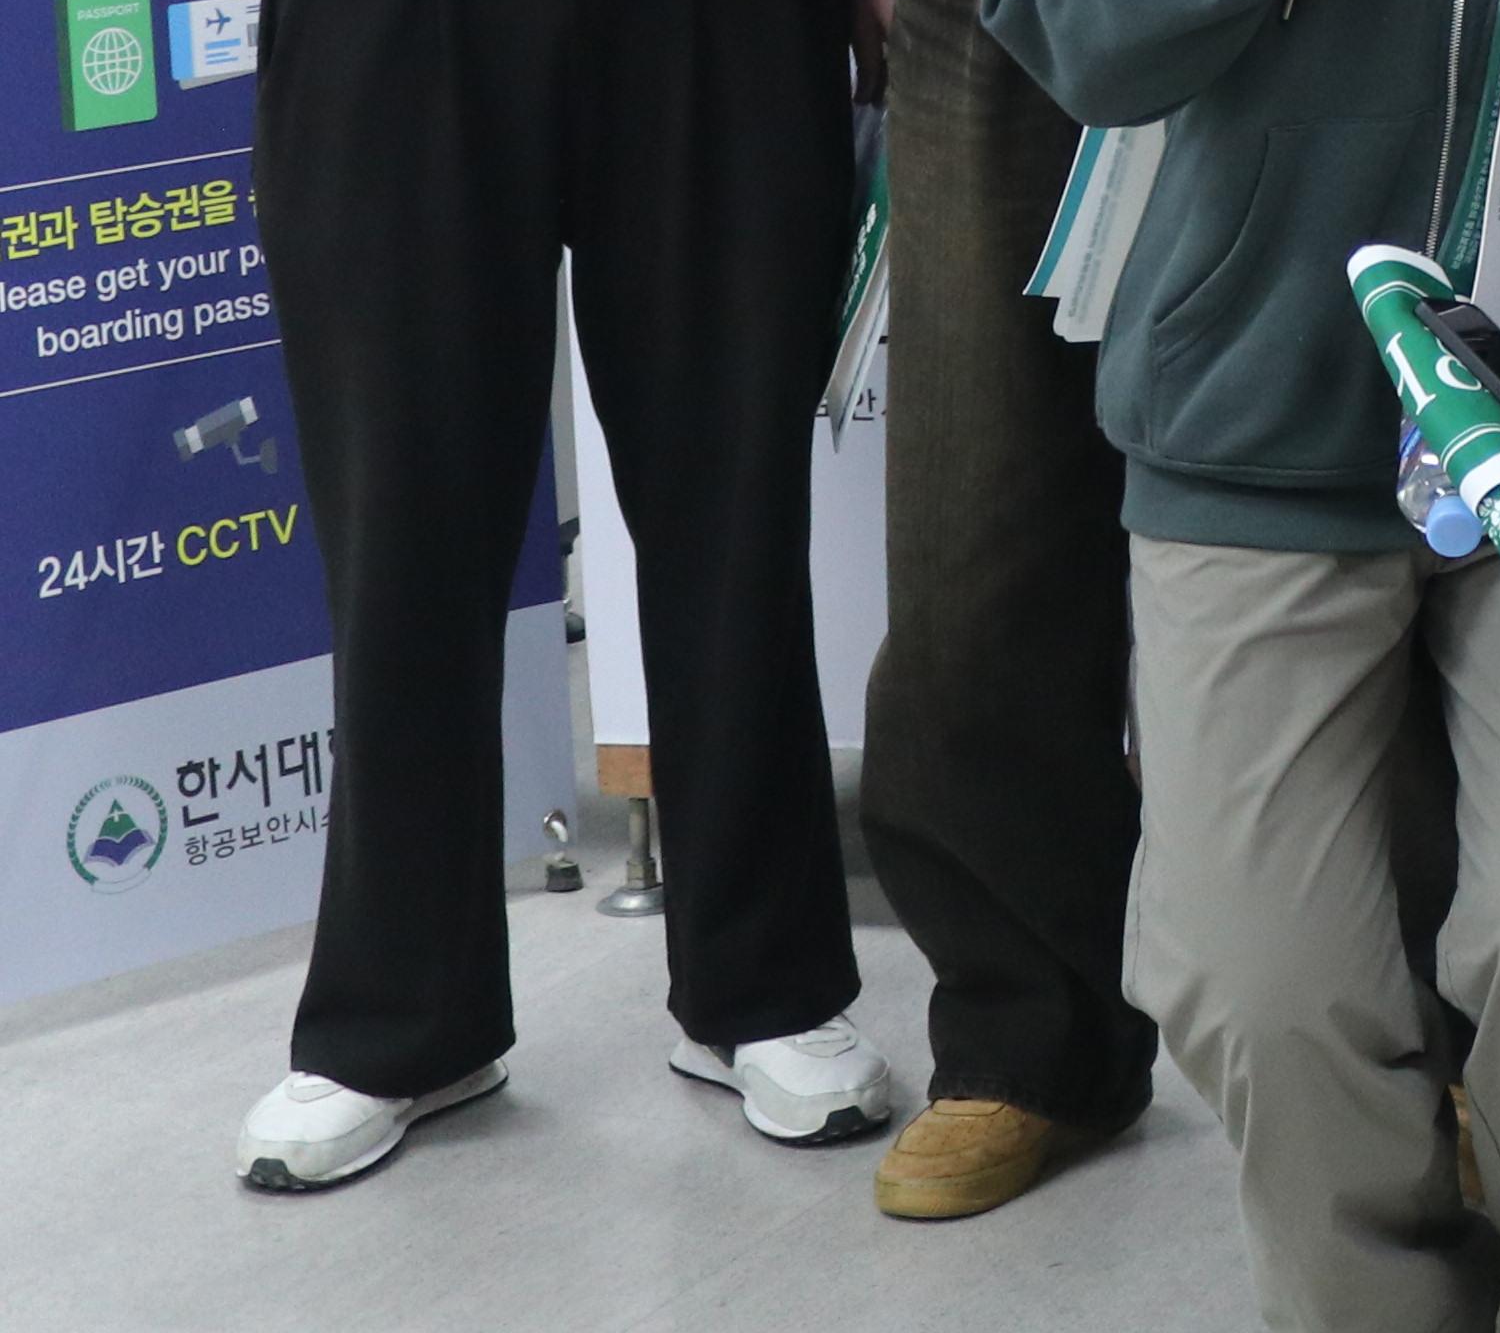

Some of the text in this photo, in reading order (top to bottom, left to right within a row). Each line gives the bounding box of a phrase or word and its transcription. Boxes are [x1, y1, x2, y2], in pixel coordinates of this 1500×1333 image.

[76, 1, 141, 23] PASSPORT
[0, 178, 239, 263] 권과 탑승권을
[0, 273, 87, 315] lease
[95, 256, 151, 300] get
[156, 245, 231, 293] your
[36, 290, 271, 359] boarding pass
[37, 503, 299, 600] 24시간 CCTV
[174, 728, 334, 829] 한서대
